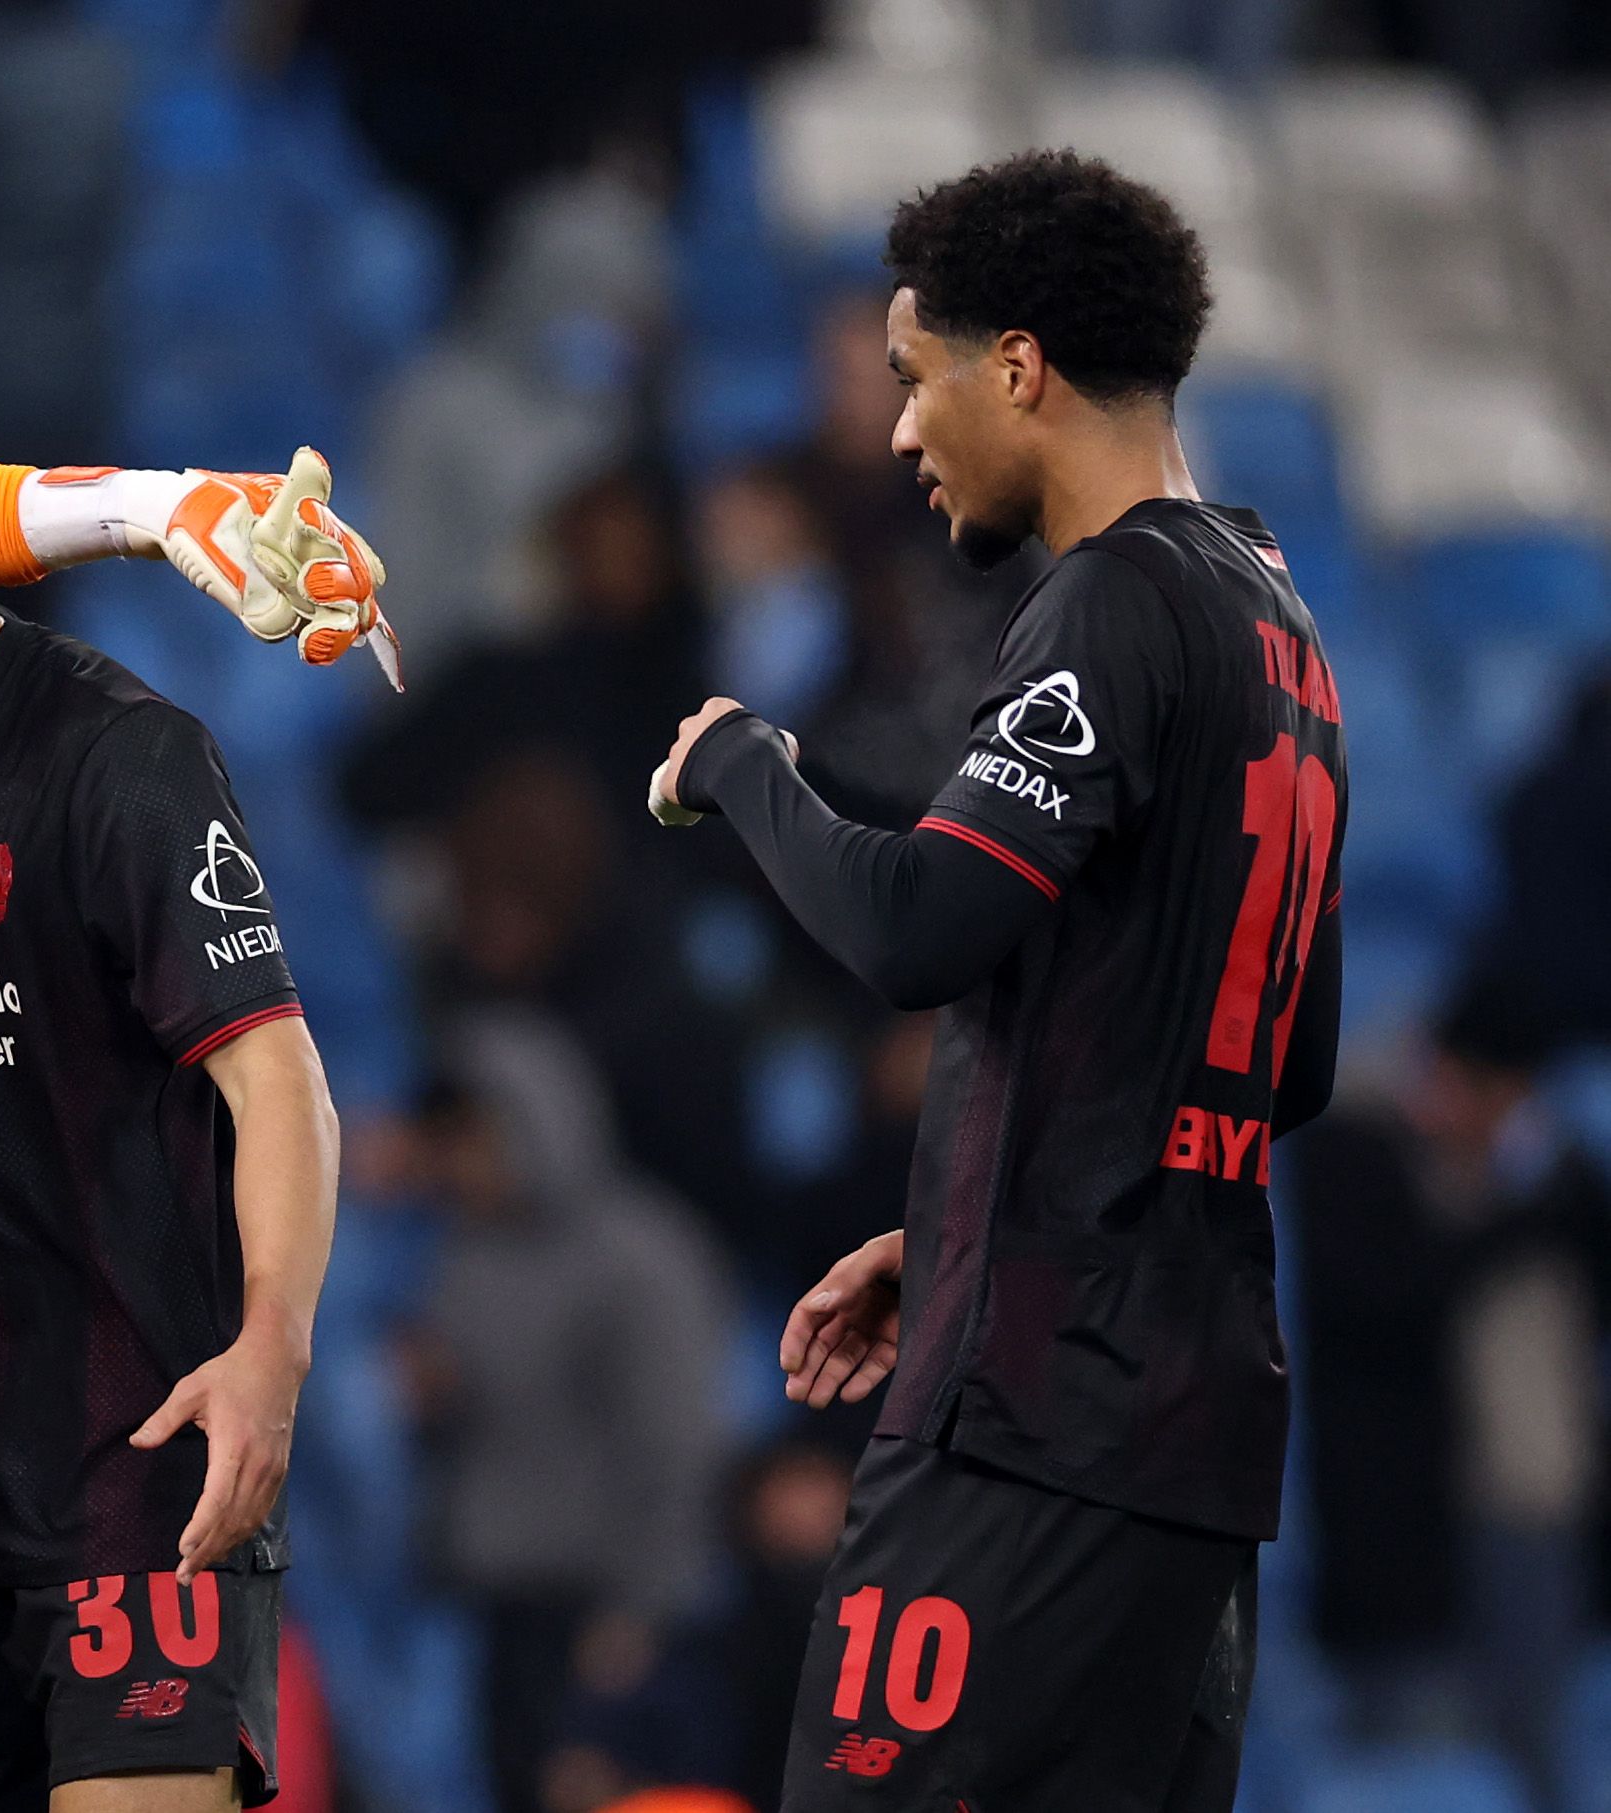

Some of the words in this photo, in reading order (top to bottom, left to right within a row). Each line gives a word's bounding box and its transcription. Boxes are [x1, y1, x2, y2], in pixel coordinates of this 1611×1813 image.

[957, 751, 1070, 820] NIEDAX
[204, 924, 284, 970] NIEDA
[1206, 732, 1336, 1090] 10
[67, 1571, 220, 1679] 30
[832, 1585, 971, 1732] 10
